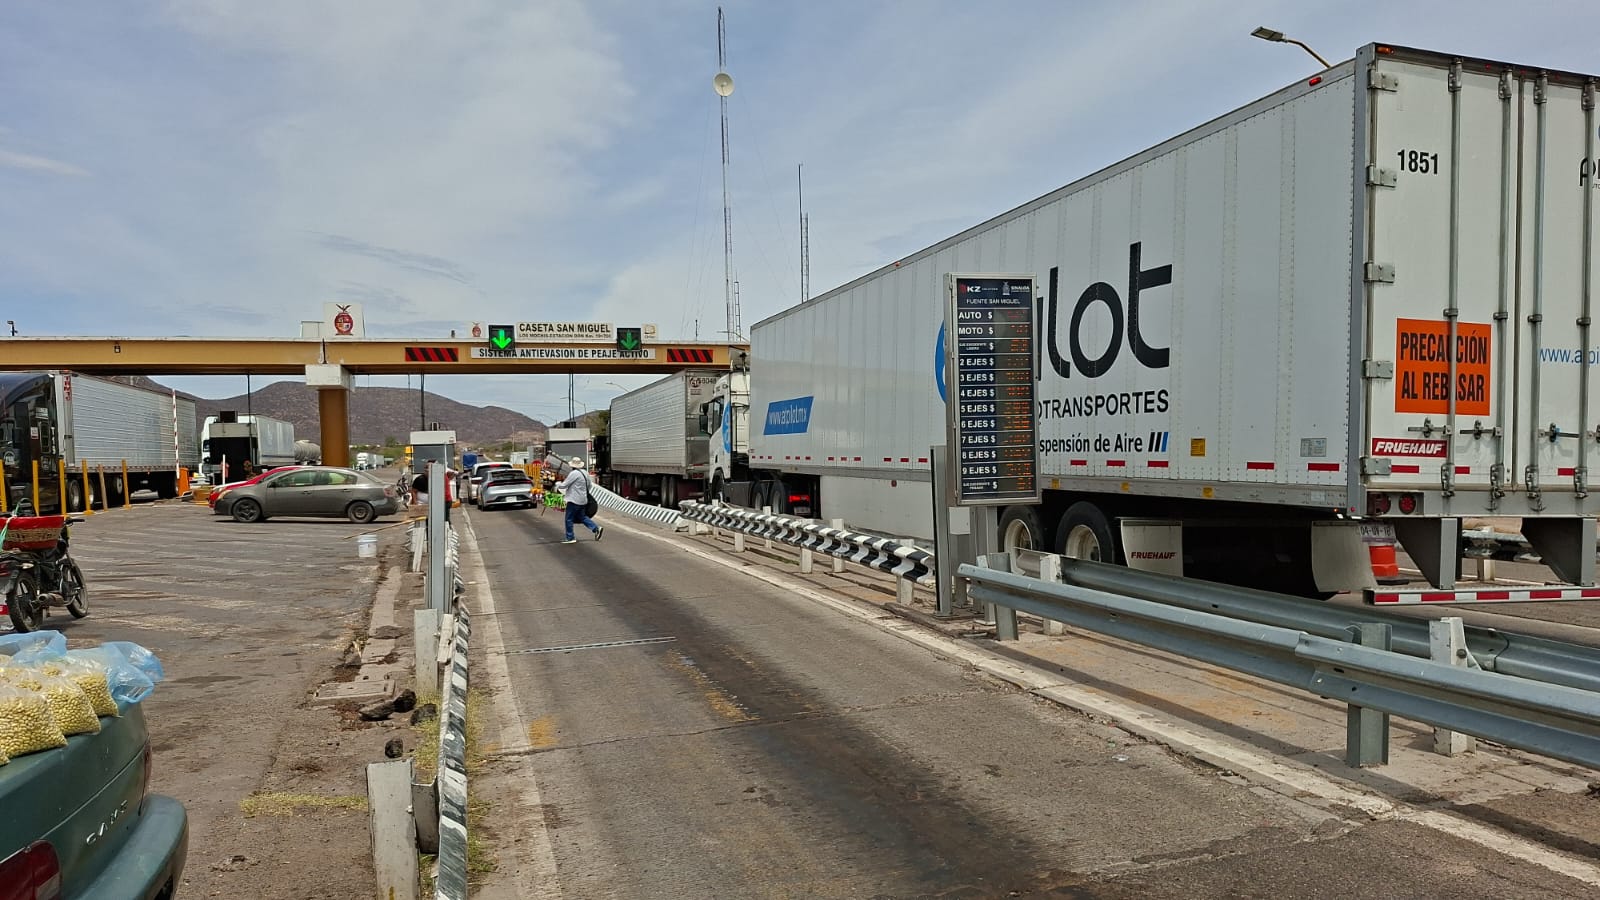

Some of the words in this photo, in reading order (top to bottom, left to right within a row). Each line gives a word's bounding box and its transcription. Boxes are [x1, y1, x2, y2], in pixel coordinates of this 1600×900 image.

[1398, 150, 1438, 174] 1851
[520, 324, 554, 332] CASETA
[556, 324, 574, 332] SAN
[578, 324, 610, 333] MIGUEL
[479, 348, 517, 358] SISTEMA
[520, 349, 575, 358] ANTIEVASION
[578, 349, 589, 358] DE
[592, 349, 617, 358] PEAJE
[620, 350, 649, 358] ACTIVO
[1402, 371, 1418, 400] AL
[1422, 372, 1485, 402] REBSAR
[1038, 389, 1169, 419] TRANSPORTES
[1039, 432, 1090, 456] spensión
[1094, 434, 1110, 452] de
[1114, 432, 1143, 452] Aire
[1374, 442, 1442, 454] FRUEHAUF
